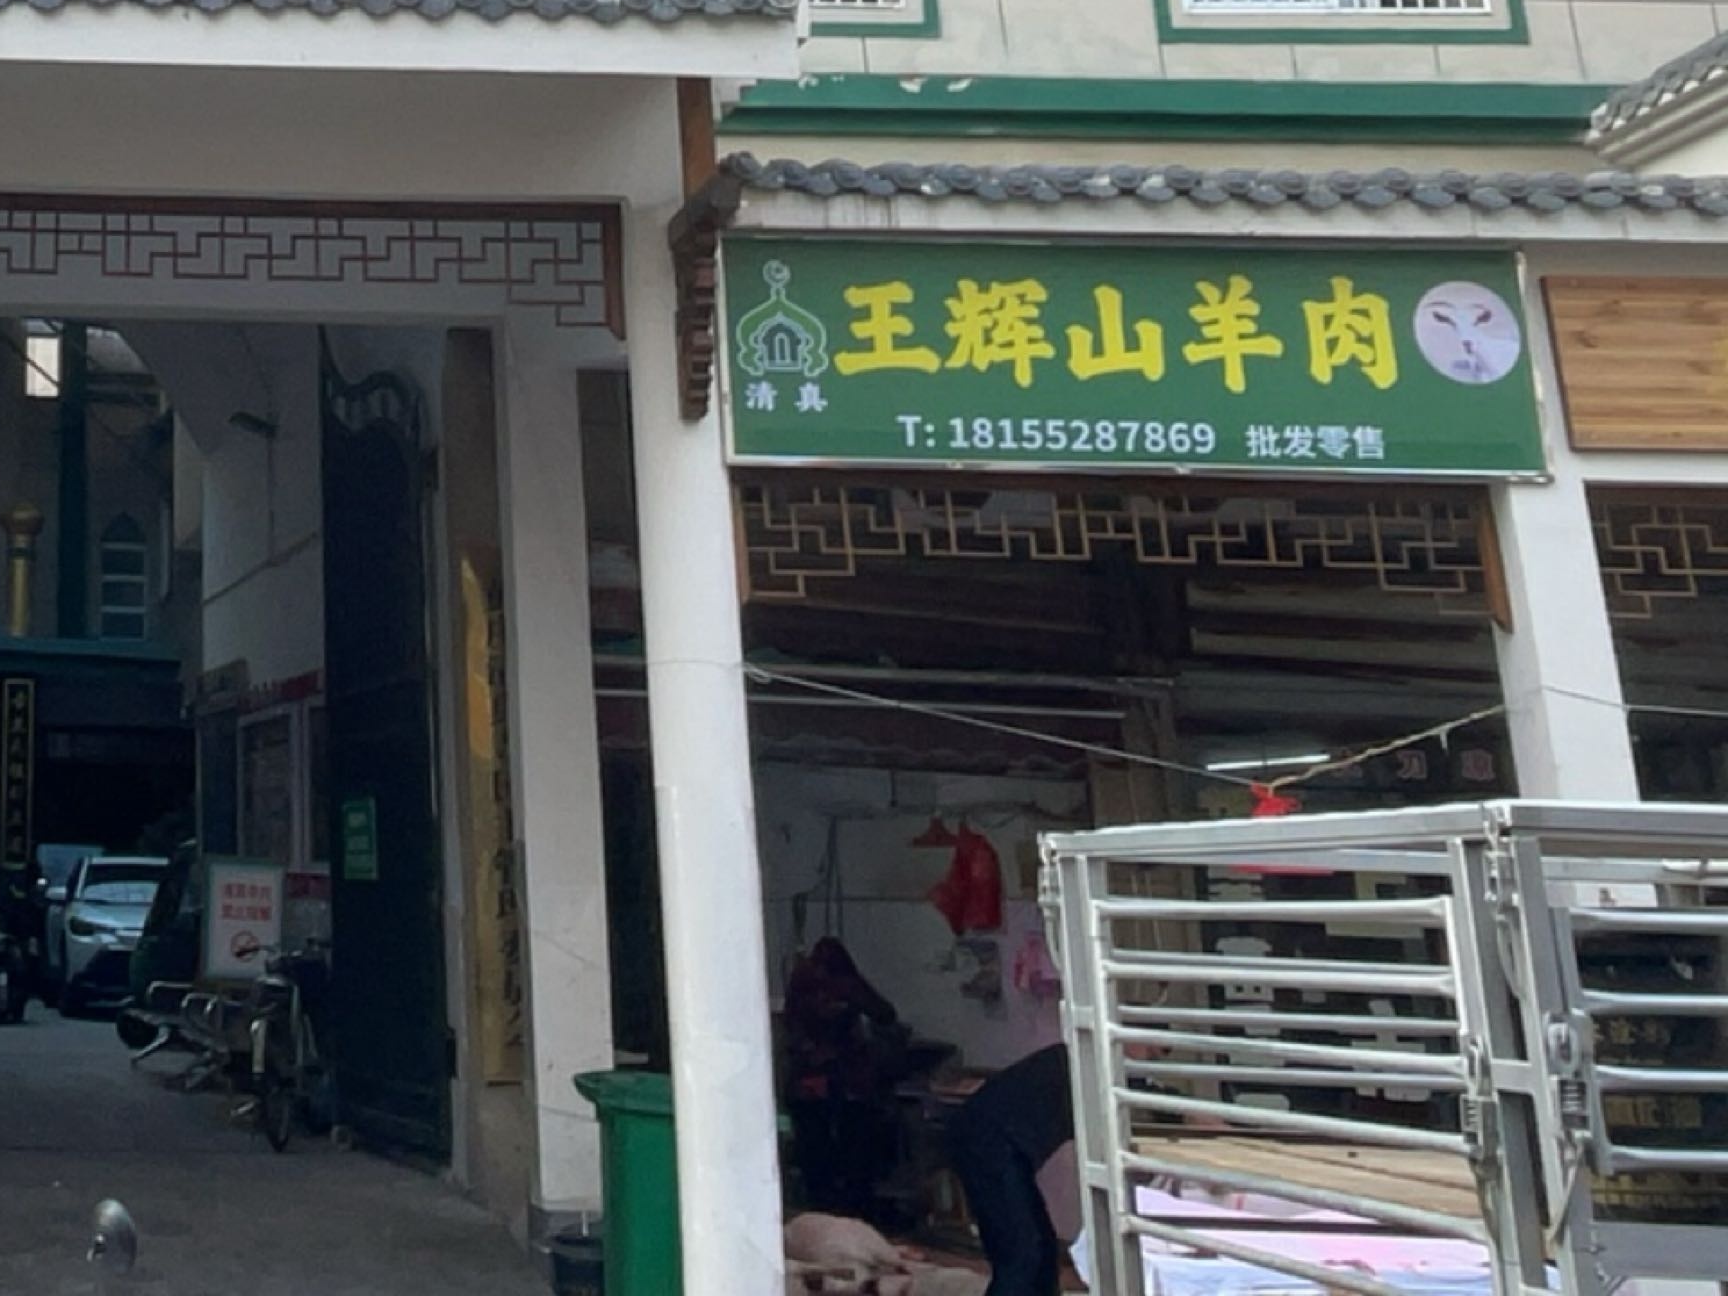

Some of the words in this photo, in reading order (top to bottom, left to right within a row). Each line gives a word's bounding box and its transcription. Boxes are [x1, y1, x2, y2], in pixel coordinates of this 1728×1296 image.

[835, 275, 1397, 391] 王辉山羊肉
[746, 381, 828, 412] 清真
[1245, 424, 1384, 460] 批发零售
